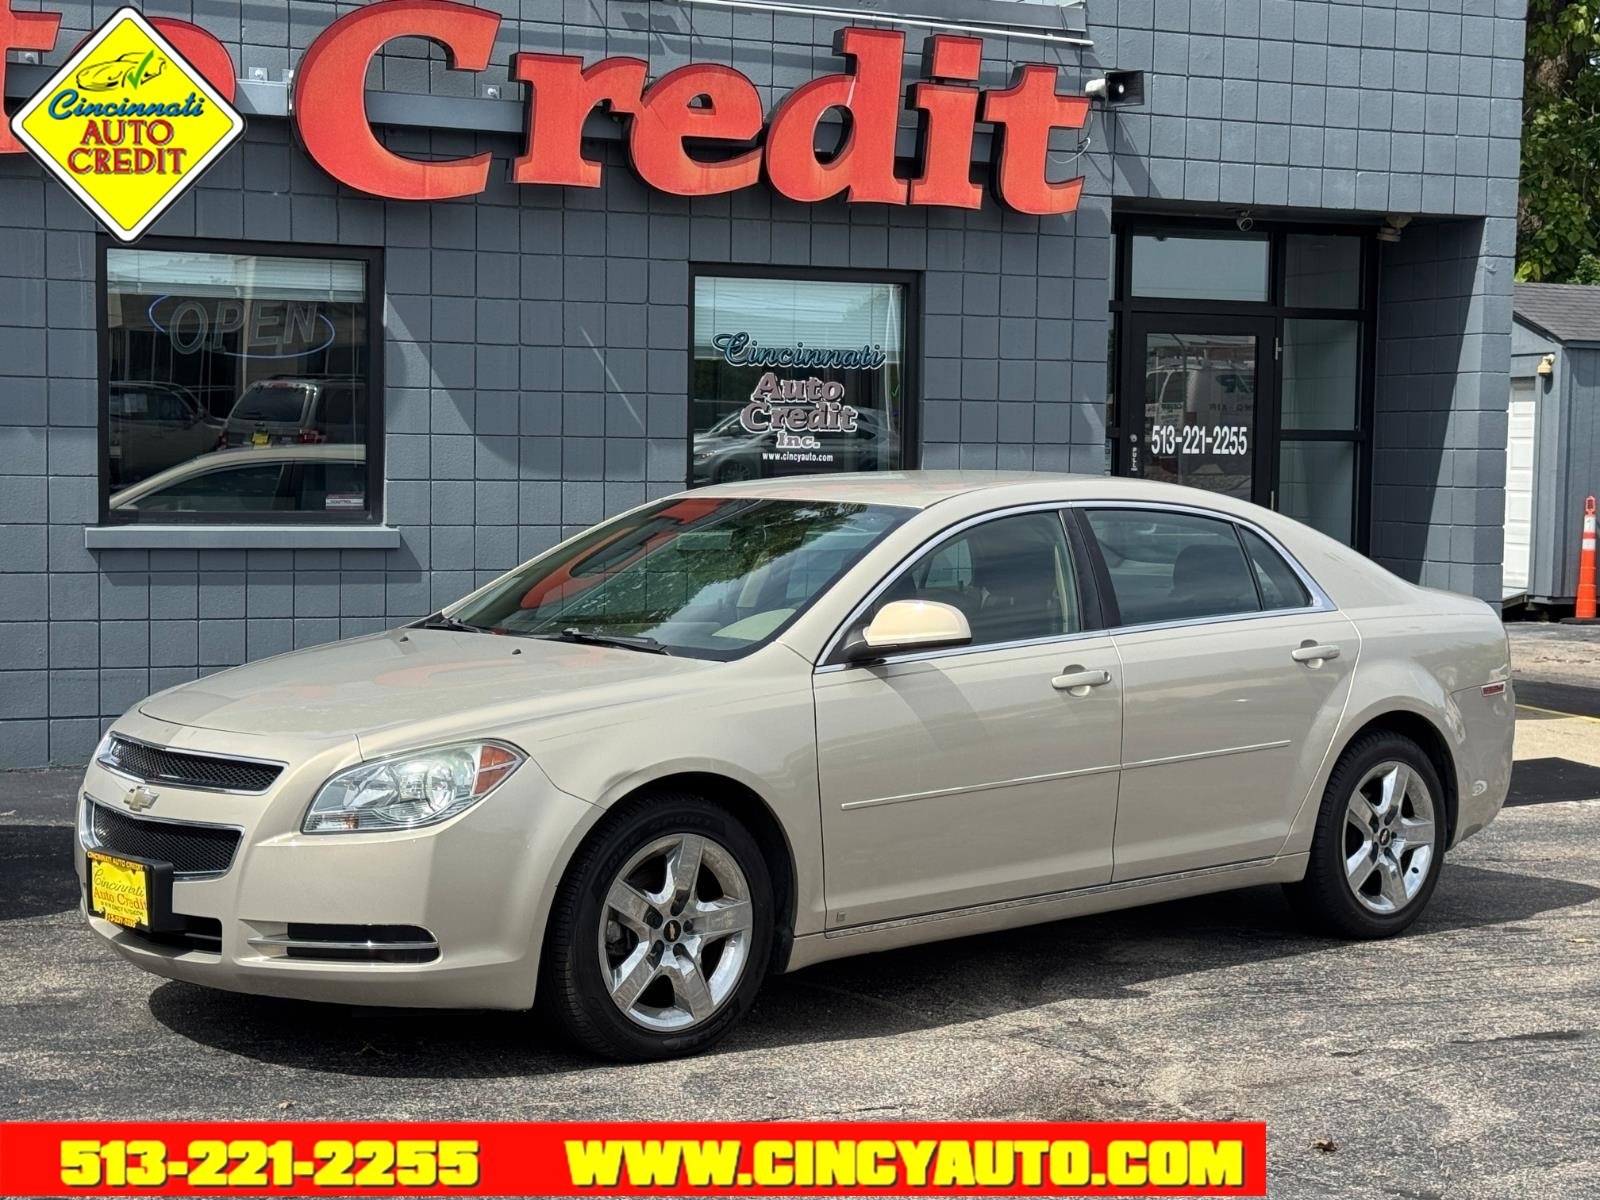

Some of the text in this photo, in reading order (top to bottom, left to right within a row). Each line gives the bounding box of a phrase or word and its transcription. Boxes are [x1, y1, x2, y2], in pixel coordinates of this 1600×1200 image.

[293, 0, 1089, 215] Credit
[169, 301, 318, 355] OPEN
[711, 331, 887, 370] Cincinnati
[750, 371, 845, 403] Auto
[740, 401, 858, 433] Credit
[776, 432, 821, 449] Inc.
[1151, 425, 1247, 455] 513-221-2255
[762, 452, 833, 463] www.cincyauto.com
[94, 886, 115, 903] Auto
